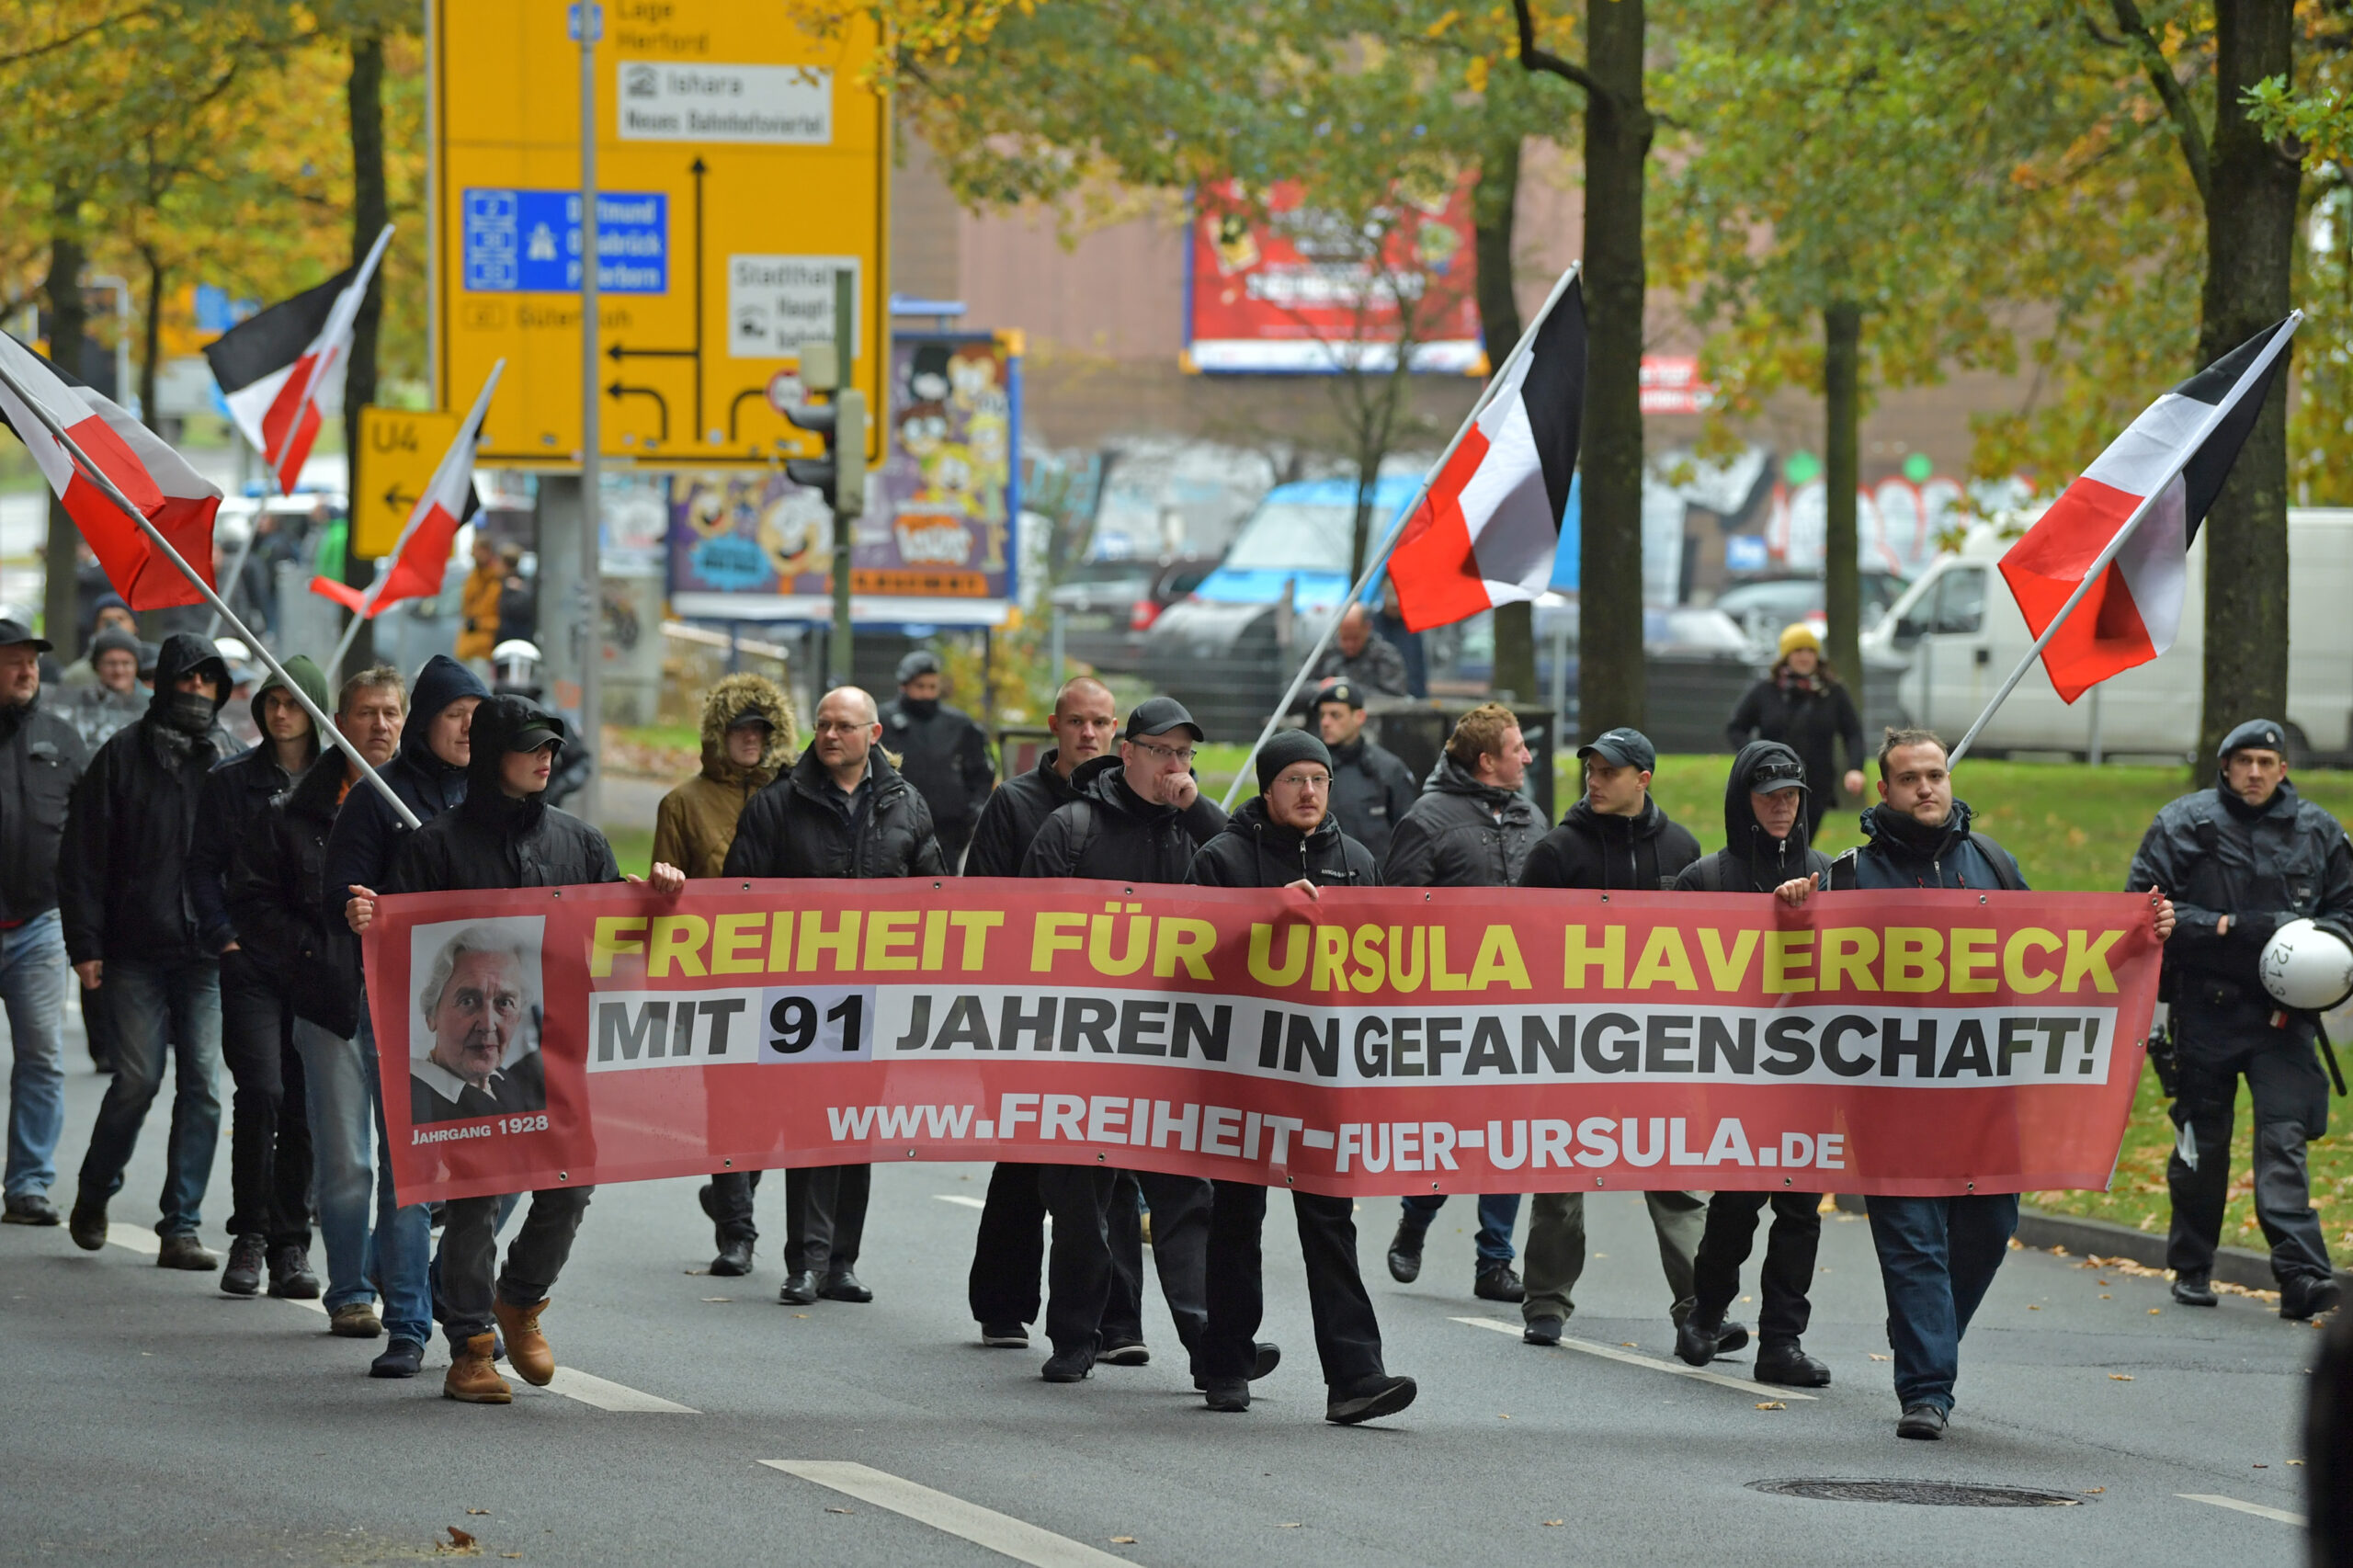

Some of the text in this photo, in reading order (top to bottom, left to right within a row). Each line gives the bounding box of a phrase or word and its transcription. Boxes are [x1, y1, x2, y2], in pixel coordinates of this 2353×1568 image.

[372, 420, 419, 454] U4
[590, 901, 2127, 994] FREIHEIT FÜR URSULA HAVERBECK
[597, 994, 2101, 1079] MIT 91 JAHREN IN GEFANGENSCHAFT!
[412, 1115, 550, 1146] JAHRGANG 1928
